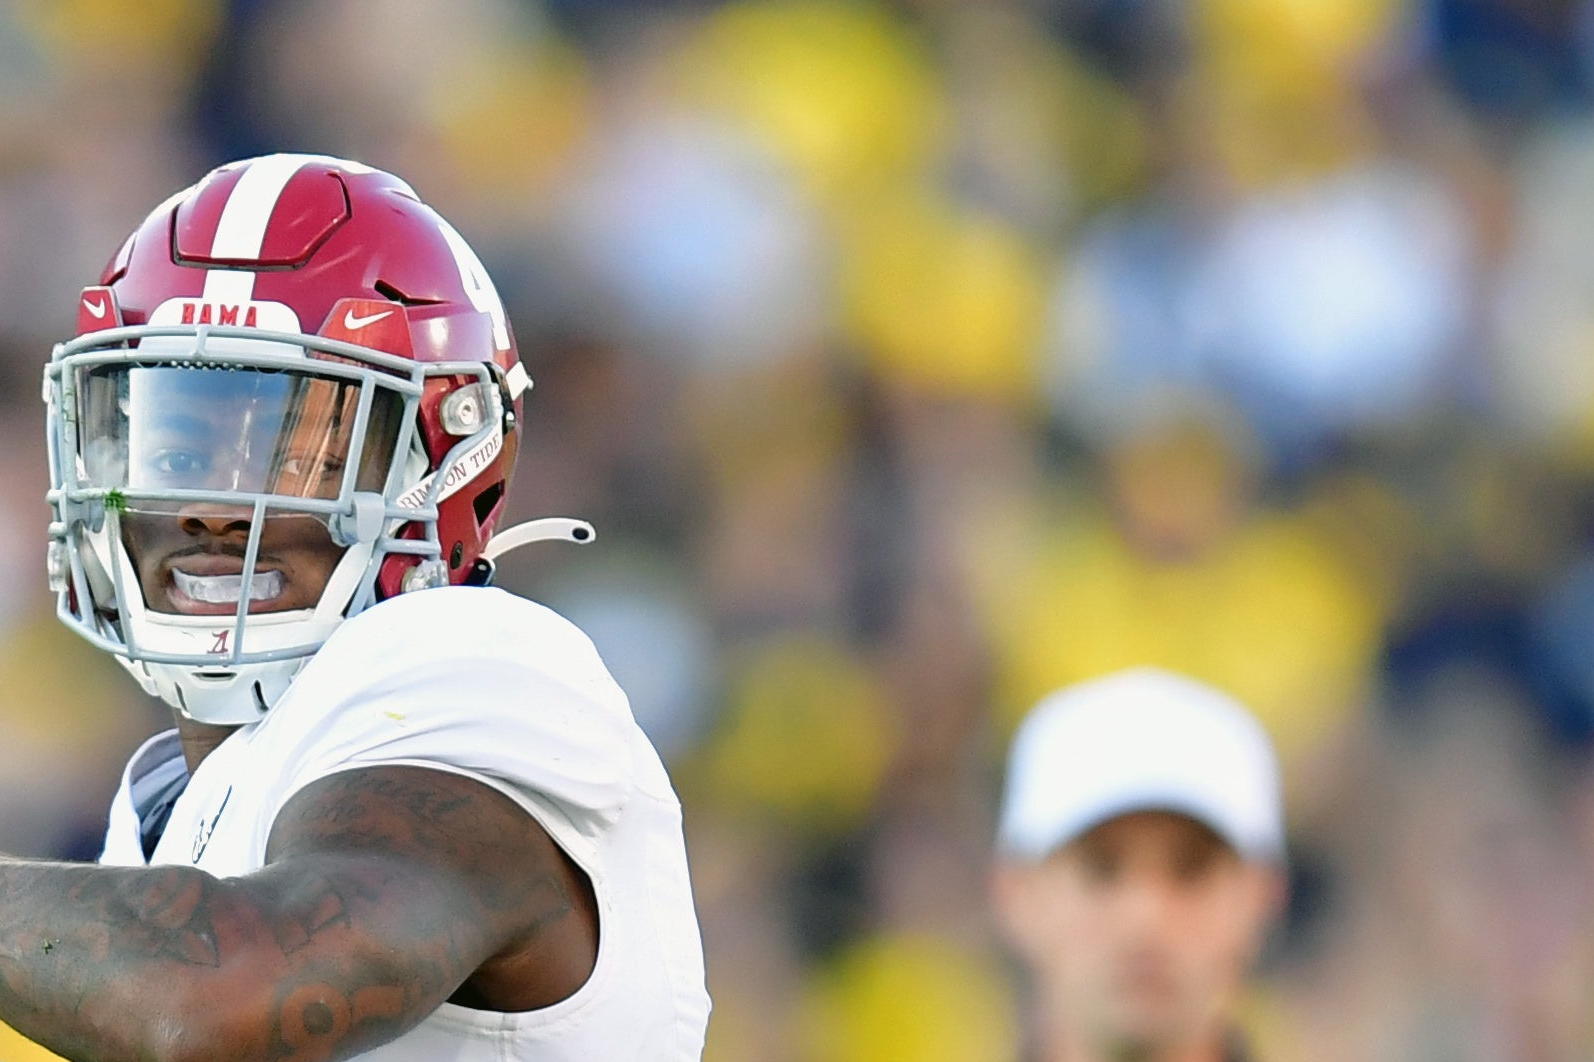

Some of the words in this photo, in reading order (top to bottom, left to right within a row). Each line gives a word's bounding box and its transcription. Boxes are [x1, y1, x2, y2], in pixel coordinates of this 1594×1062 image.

[181, 303, 257, 328] BAMA
[399, 462, 468, 509] RIMON
[469, 433, 501, 468] TIDE
